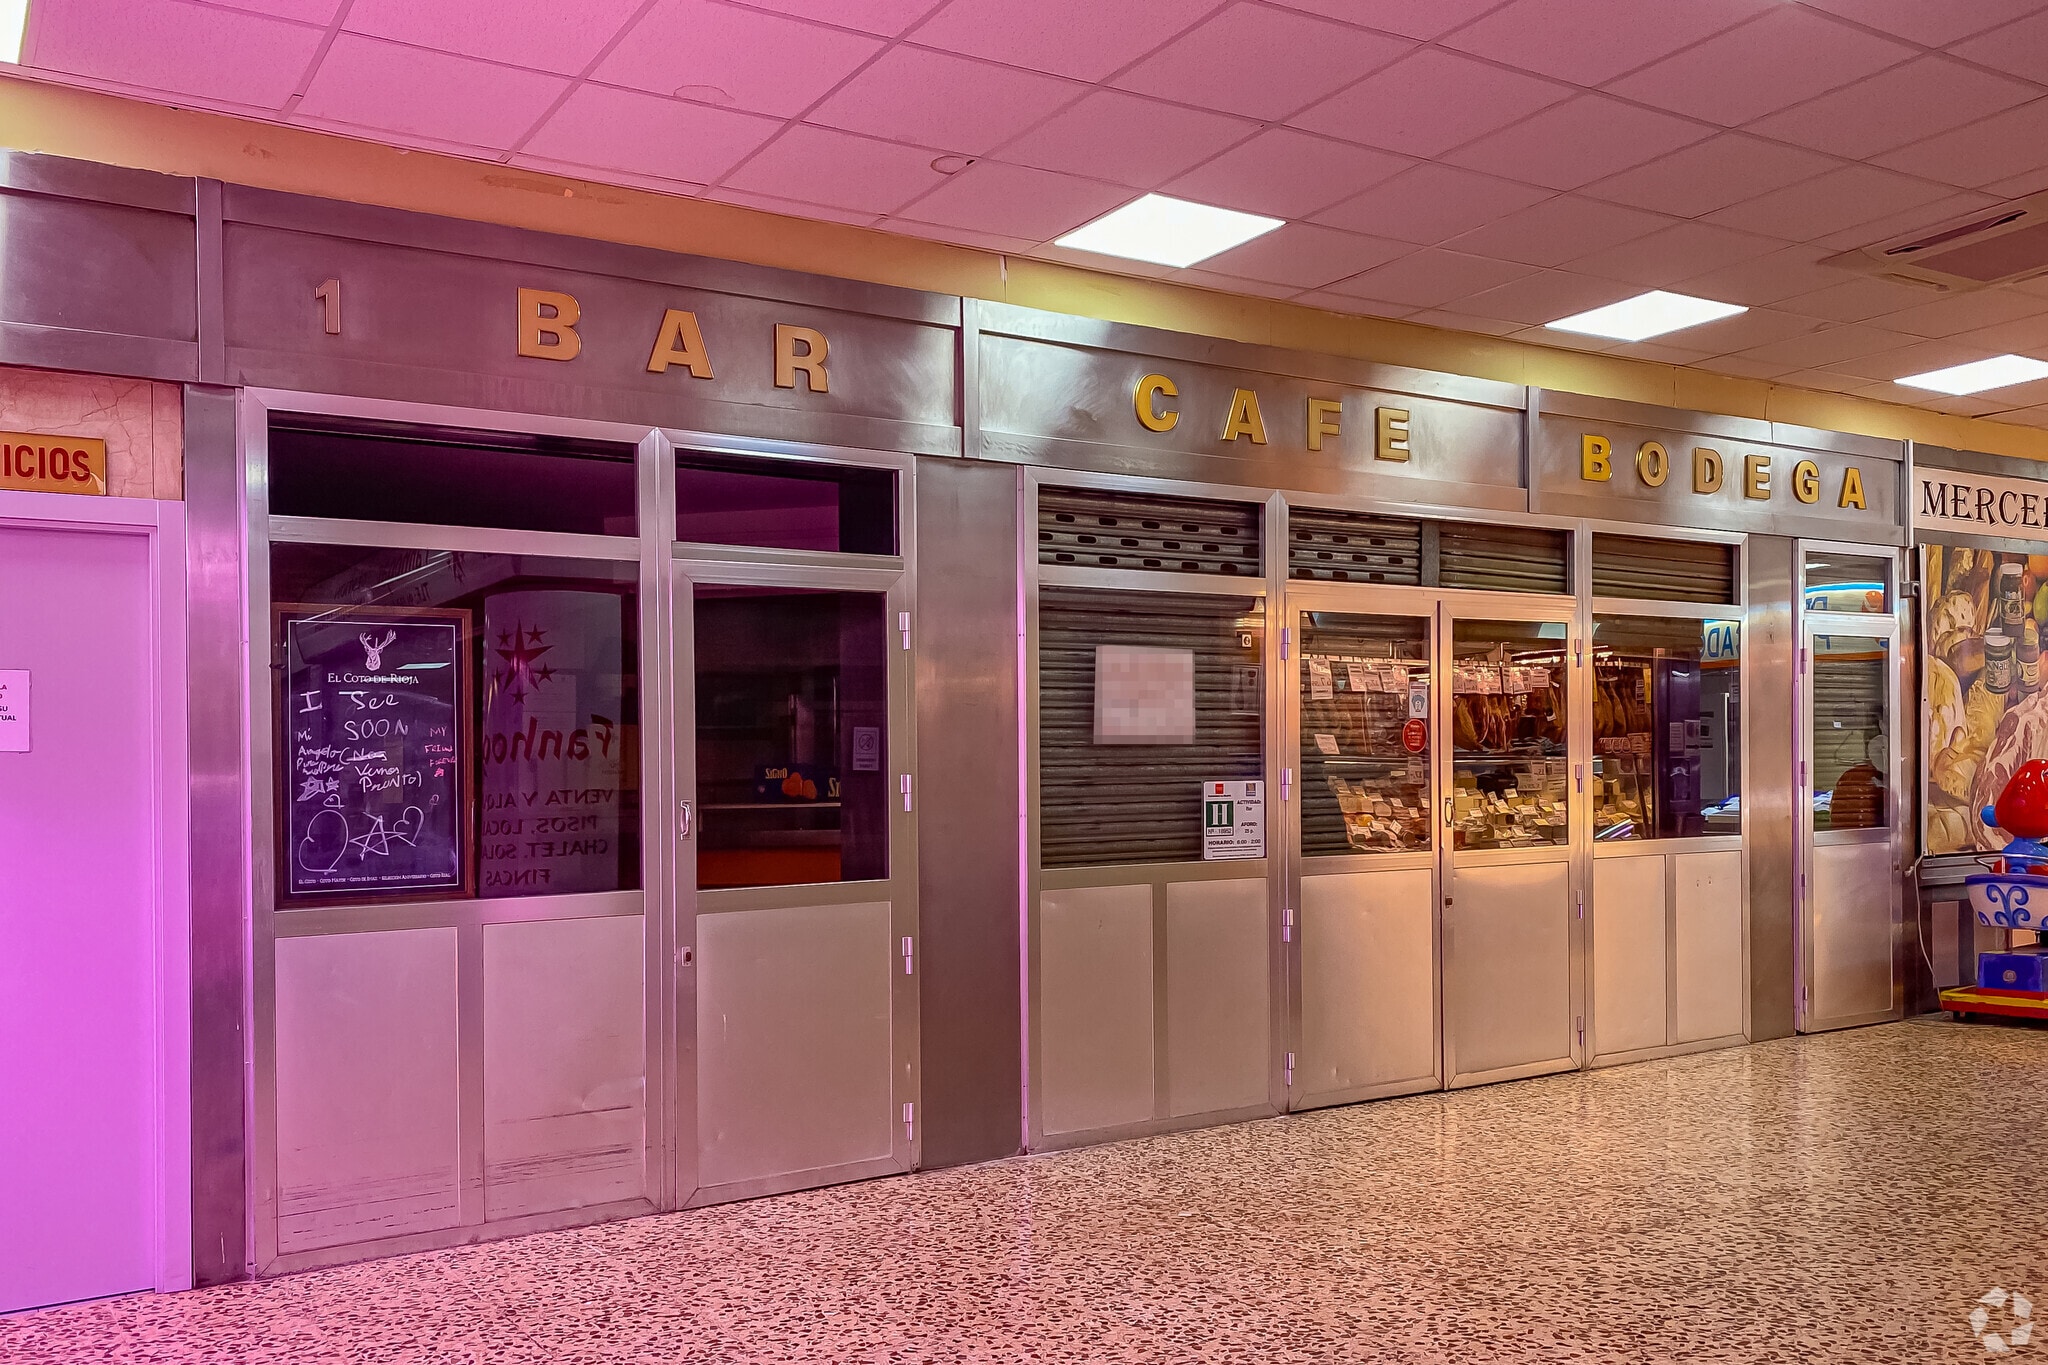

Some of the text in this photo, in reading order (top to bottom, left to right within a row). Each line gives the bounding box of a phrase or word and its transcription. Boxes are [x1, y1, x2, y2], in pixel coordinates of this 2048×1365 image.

[315, 277, 341, 334] 1
[517, 286, 1867, 510] BAR CAFE BODEGA
[0, 444, 91, 482] ICIOS
